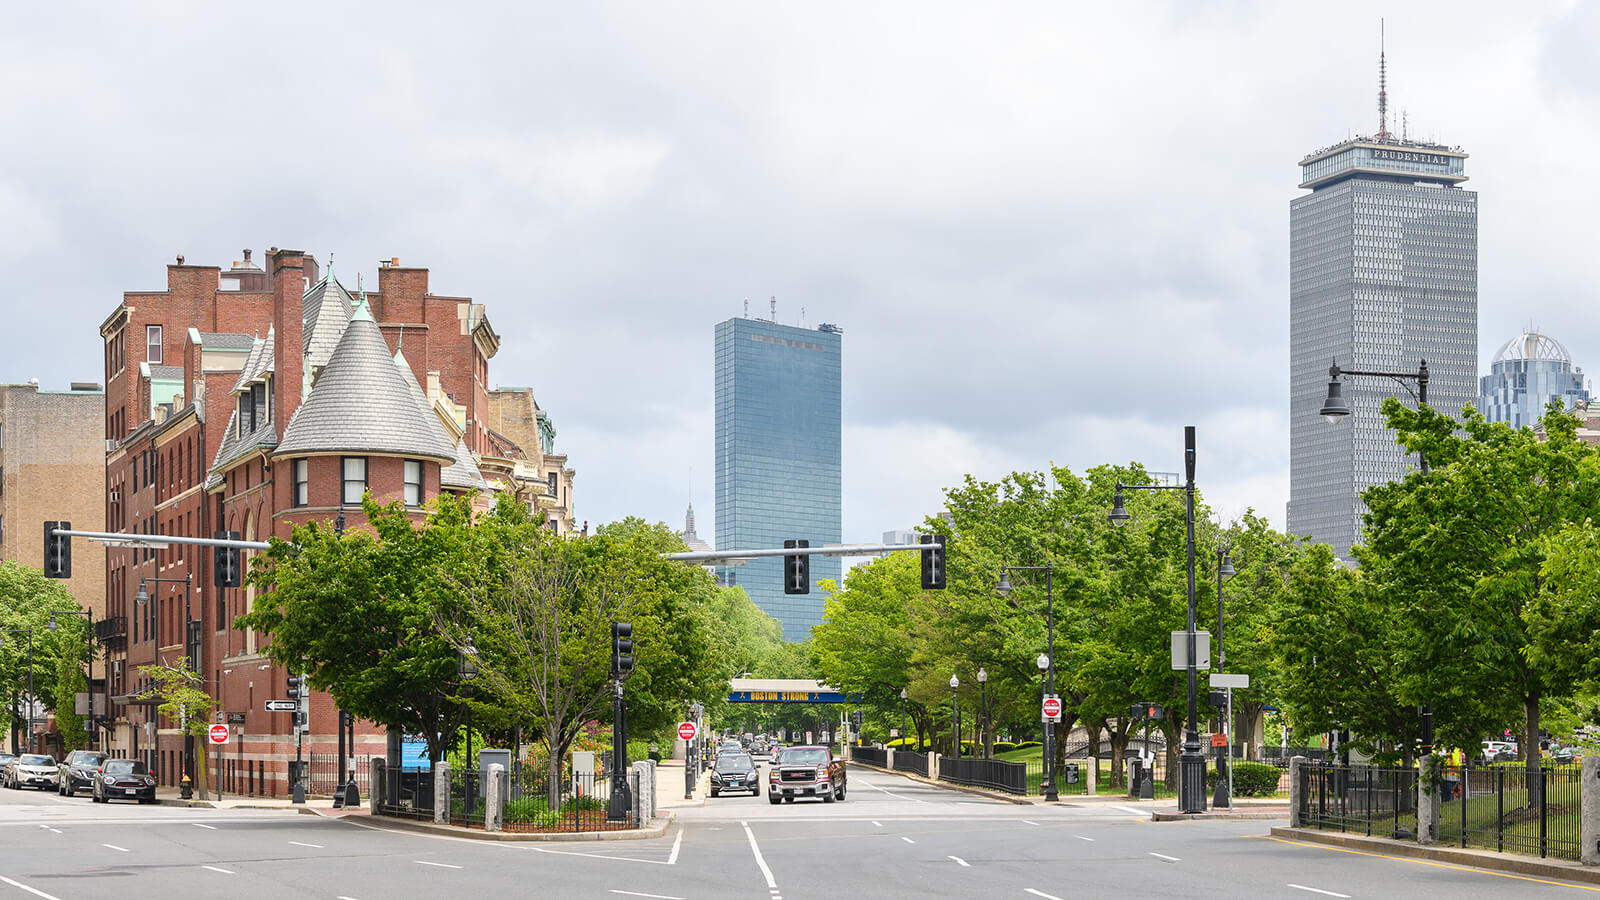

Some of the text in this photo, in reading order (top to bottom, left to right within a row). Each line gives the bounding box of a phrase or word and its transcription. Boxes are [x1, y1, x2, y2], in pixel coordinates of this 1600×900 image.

[1374, 150, 1447, 164] PRUDENTIAL
[750, 692, 809, 701] BOSTON STRONG
